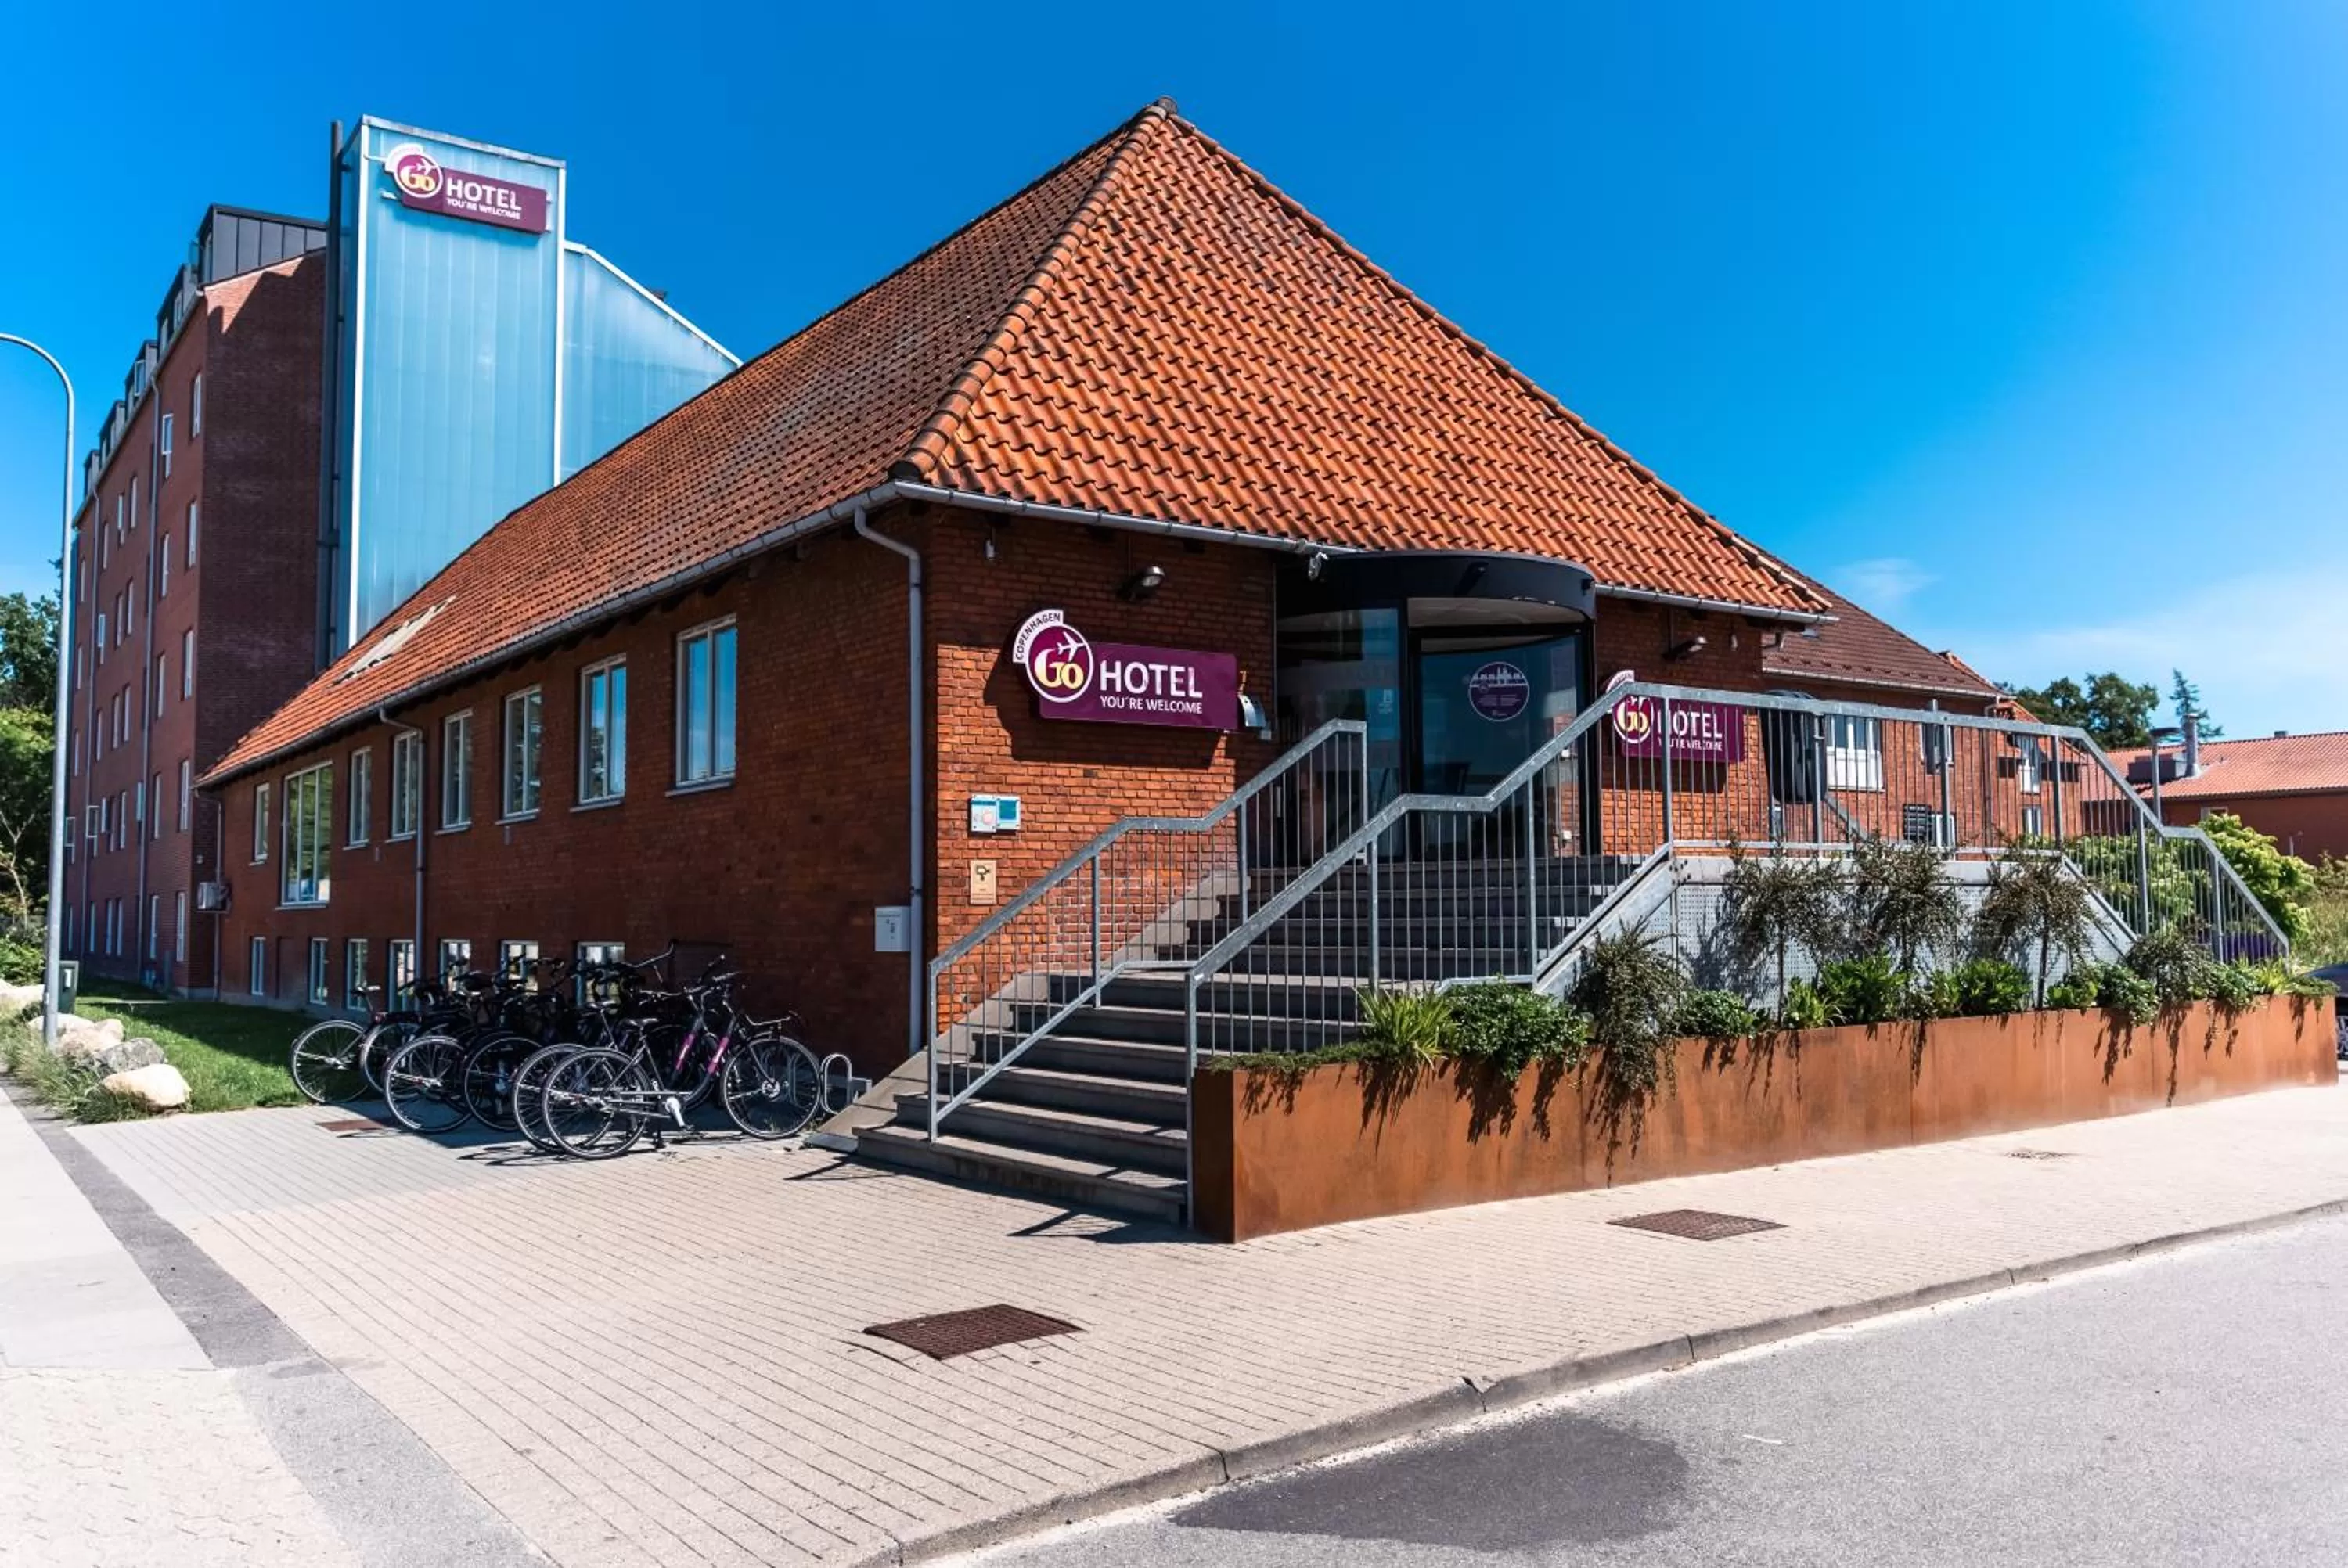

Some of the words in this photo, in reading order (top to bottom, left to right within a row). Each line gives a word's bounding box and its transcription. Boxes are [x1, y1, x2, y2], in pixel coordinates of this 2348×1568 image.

[400, 165, 436, 192] Go
[447, 178, 522, 211] HOTEL
[1015, 613, 1061, 660] COPENHAGEN
[1035, 648, 1084, 689] Go
[1100, 660, 1203, 698] HOTEL
[1145, 699, 1203, 714] WELCOME
